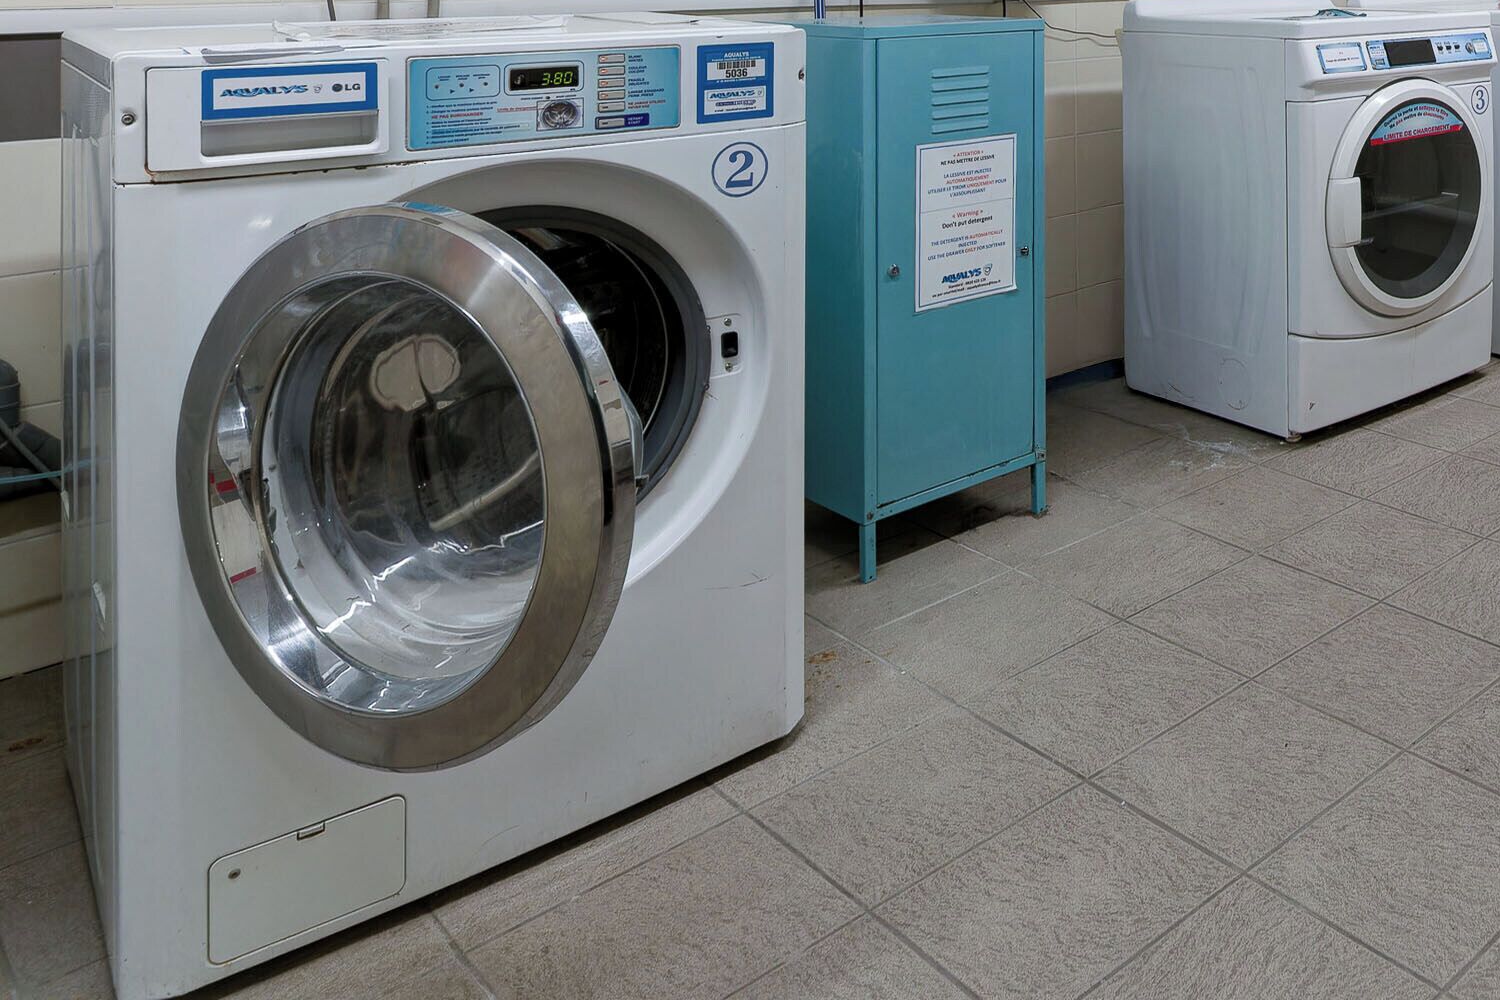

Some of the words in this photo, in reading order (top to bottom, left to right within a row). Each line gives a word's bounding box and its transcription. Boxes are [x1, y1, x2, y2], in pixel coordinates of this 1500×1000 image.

[541, 71, 574, 86] 3.80
[725, 68, 748, 78] 5036
[219, 84, 309, 98] AQUALYS
[344, 83, 361, 91] LG
[1475, 89, 1486, 110] 3
[1384, 131, 1403, 140] LIMITE
[1412, 123, 1451, 136] CHARGEMENT
[724, 150, 755, 190] 2
[945, 174, 989, 184] AUTOMATIQUEMENT
[967, 179, 994, 188] UNIQUEMENT
[956, 209, 979, 218] Warning
[942, 221, 957, 229] Don't
[957, 219, 967, 227] put
[968, 215, 993, 225] detergent
[939, 236, 964, 245] DETERGENT
[969, 229, 1004, 240] AUTOMATICALLY
[958, 240, 978, 248] INJECTED
[985, 241, 1006, 249] SOFTENER
[941, 267, 982, 284] AQUALYS
